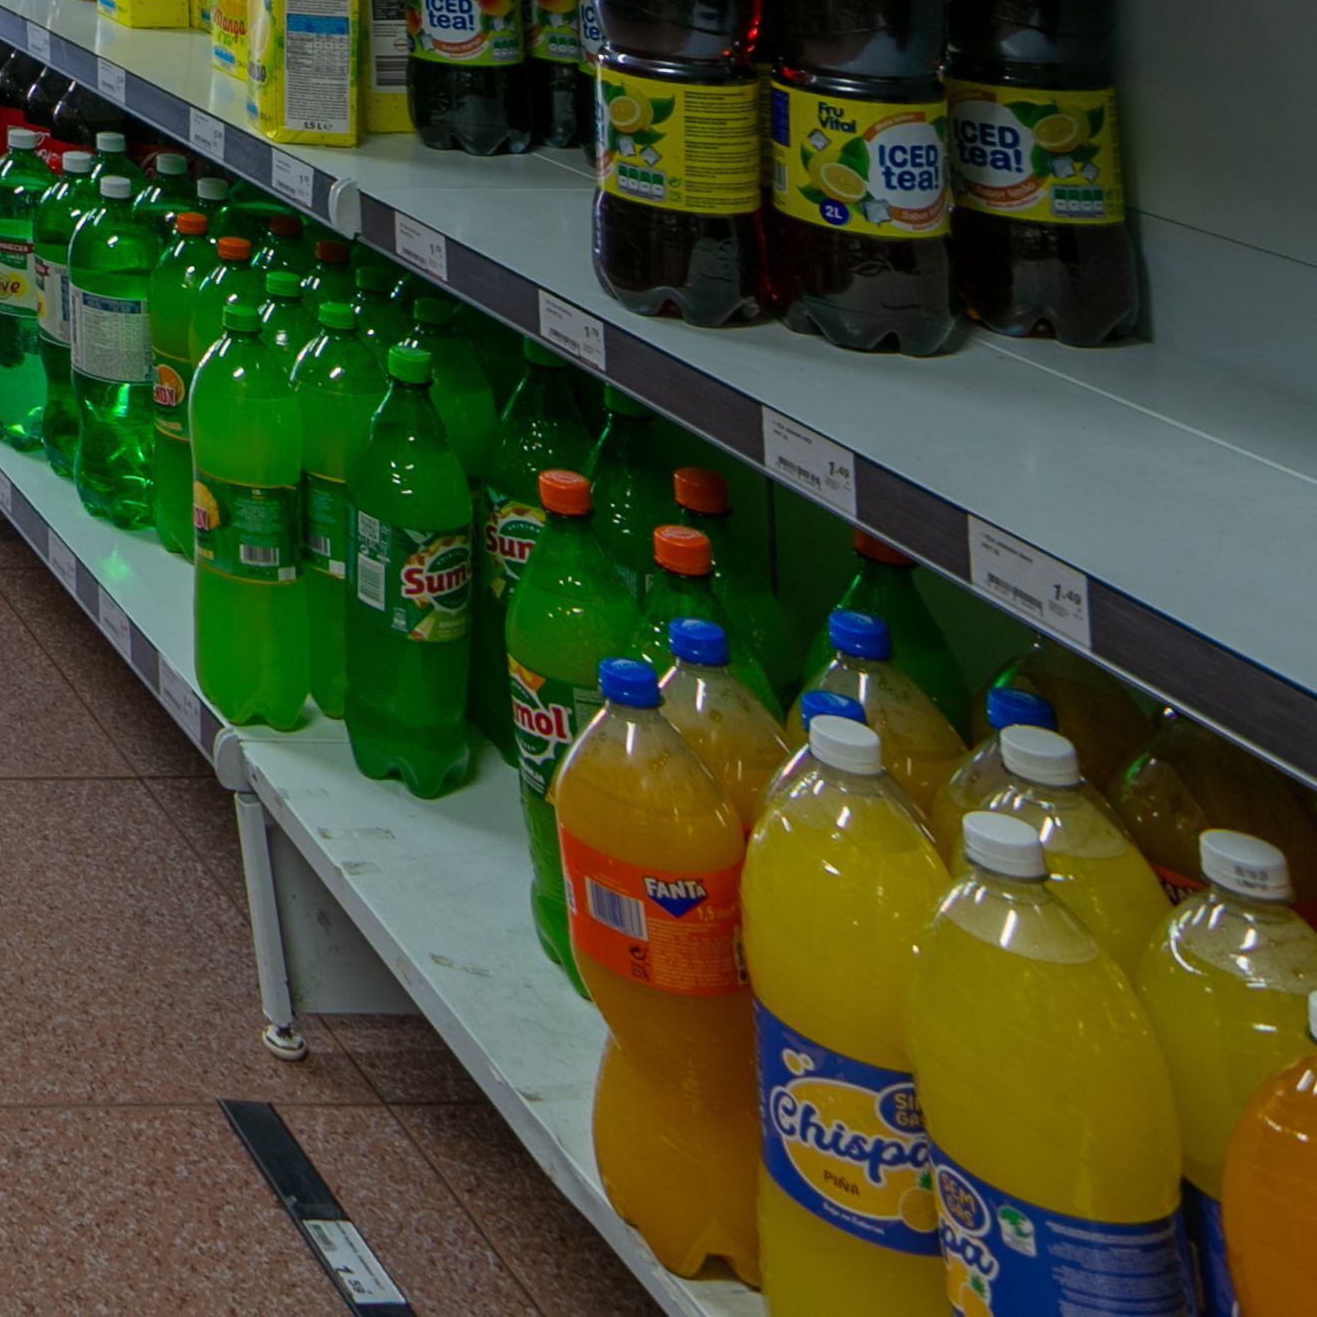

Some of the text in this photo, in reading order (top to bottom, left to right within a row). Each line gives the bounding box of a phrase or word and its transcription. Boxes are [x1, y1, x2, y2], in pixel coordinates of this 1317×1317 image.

[428, 11, 475, 31] tea!
[818, 101, 844, 118] Fru
[818, 115, 856, 133] Vital
[954, 118, 1020, 149] ICED
[878, 145, 939, 168] ICED
[882, 167, 939, 191] tea!
[824, 205, 844, 220] 2L
[405, 564, 469, 594] Sum
[514, 704, 567, 739] mol
[644, 877, 706, 899] FANTA
[823, 1170, 860, 1198] PIÑA
